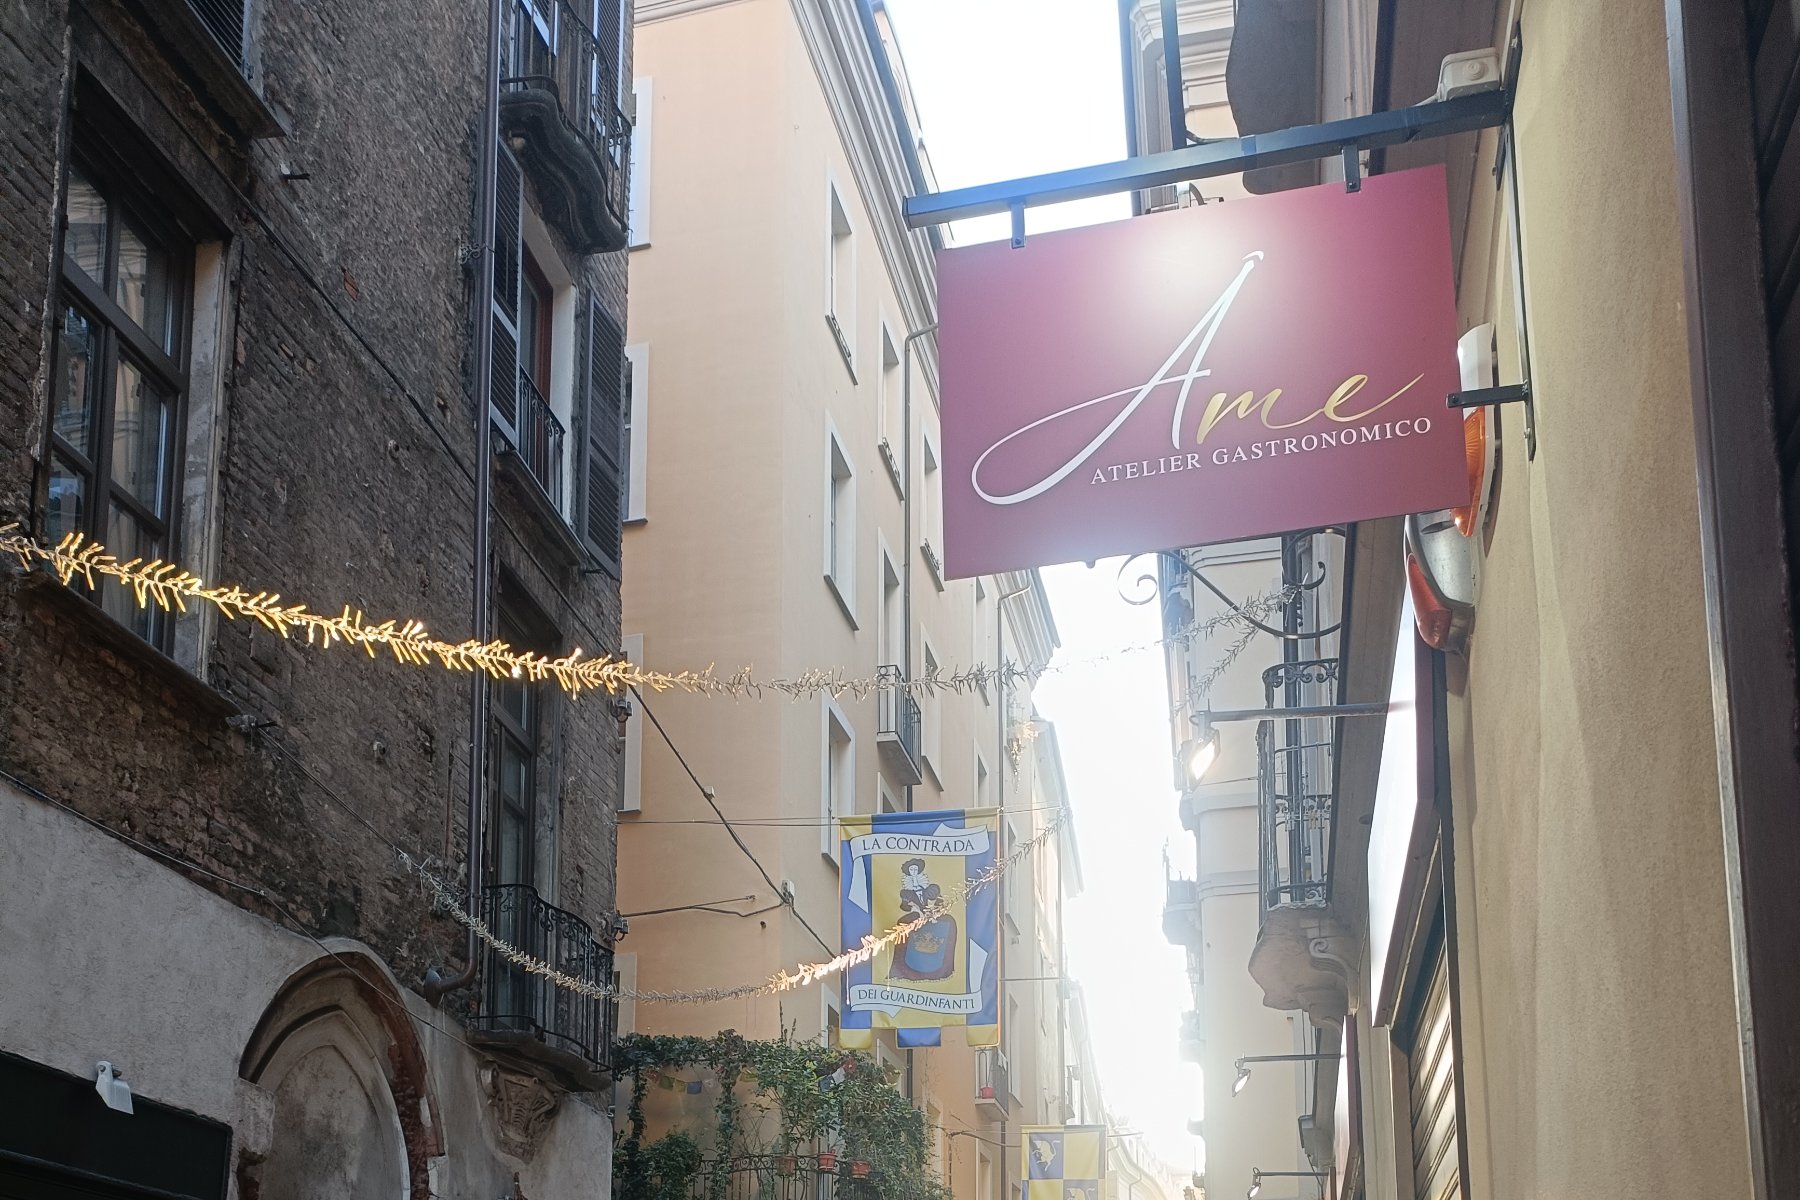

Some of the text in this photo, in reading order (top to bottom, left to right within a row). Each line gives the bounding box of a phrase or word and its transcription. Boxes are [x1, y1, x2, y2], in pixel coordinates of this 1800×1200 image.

[1090, 416, 1433, 485] ATELIER GASTRONOMICO
[862, 836, 976, 853] LA CONTRADA
[857, 988, 976, 1010] DEI GUARDINFANTI
